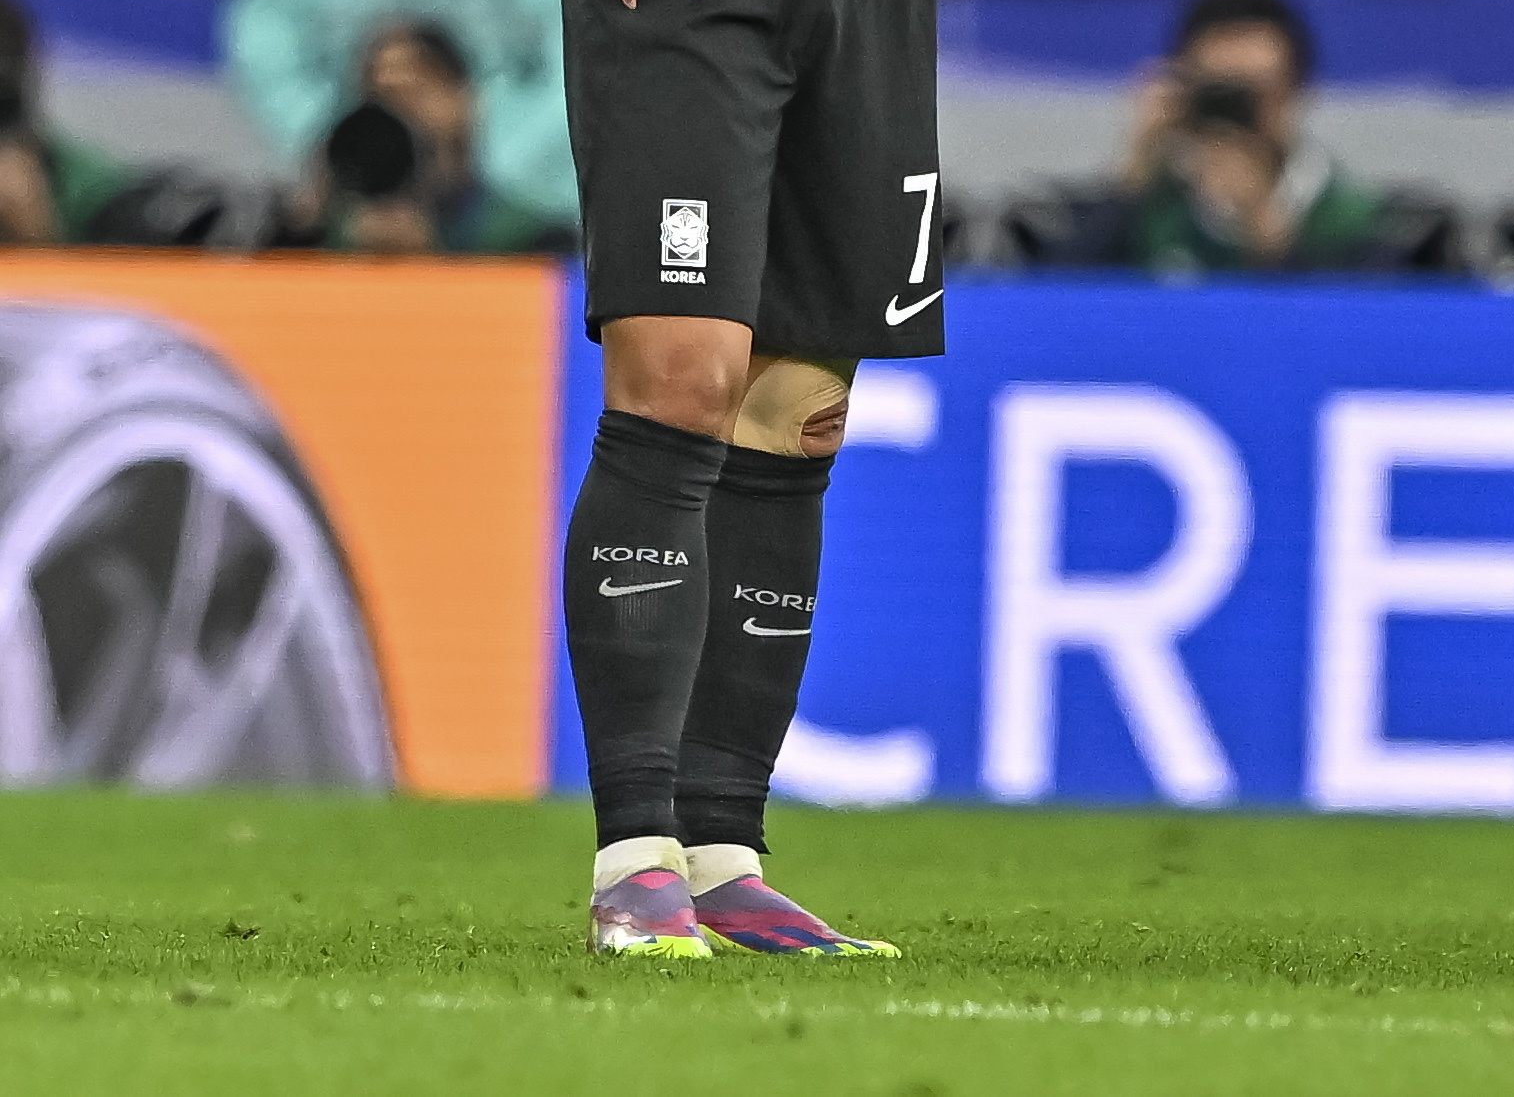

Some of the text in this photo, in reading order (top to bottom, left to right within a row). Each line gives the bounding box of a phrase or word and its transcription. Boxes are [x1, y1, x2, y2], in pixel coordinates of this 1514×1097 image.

[903, 172, 938, 284] 7
[660, 270, 707, 284] KOREA
[592, 546, 690, 567] KOREA
